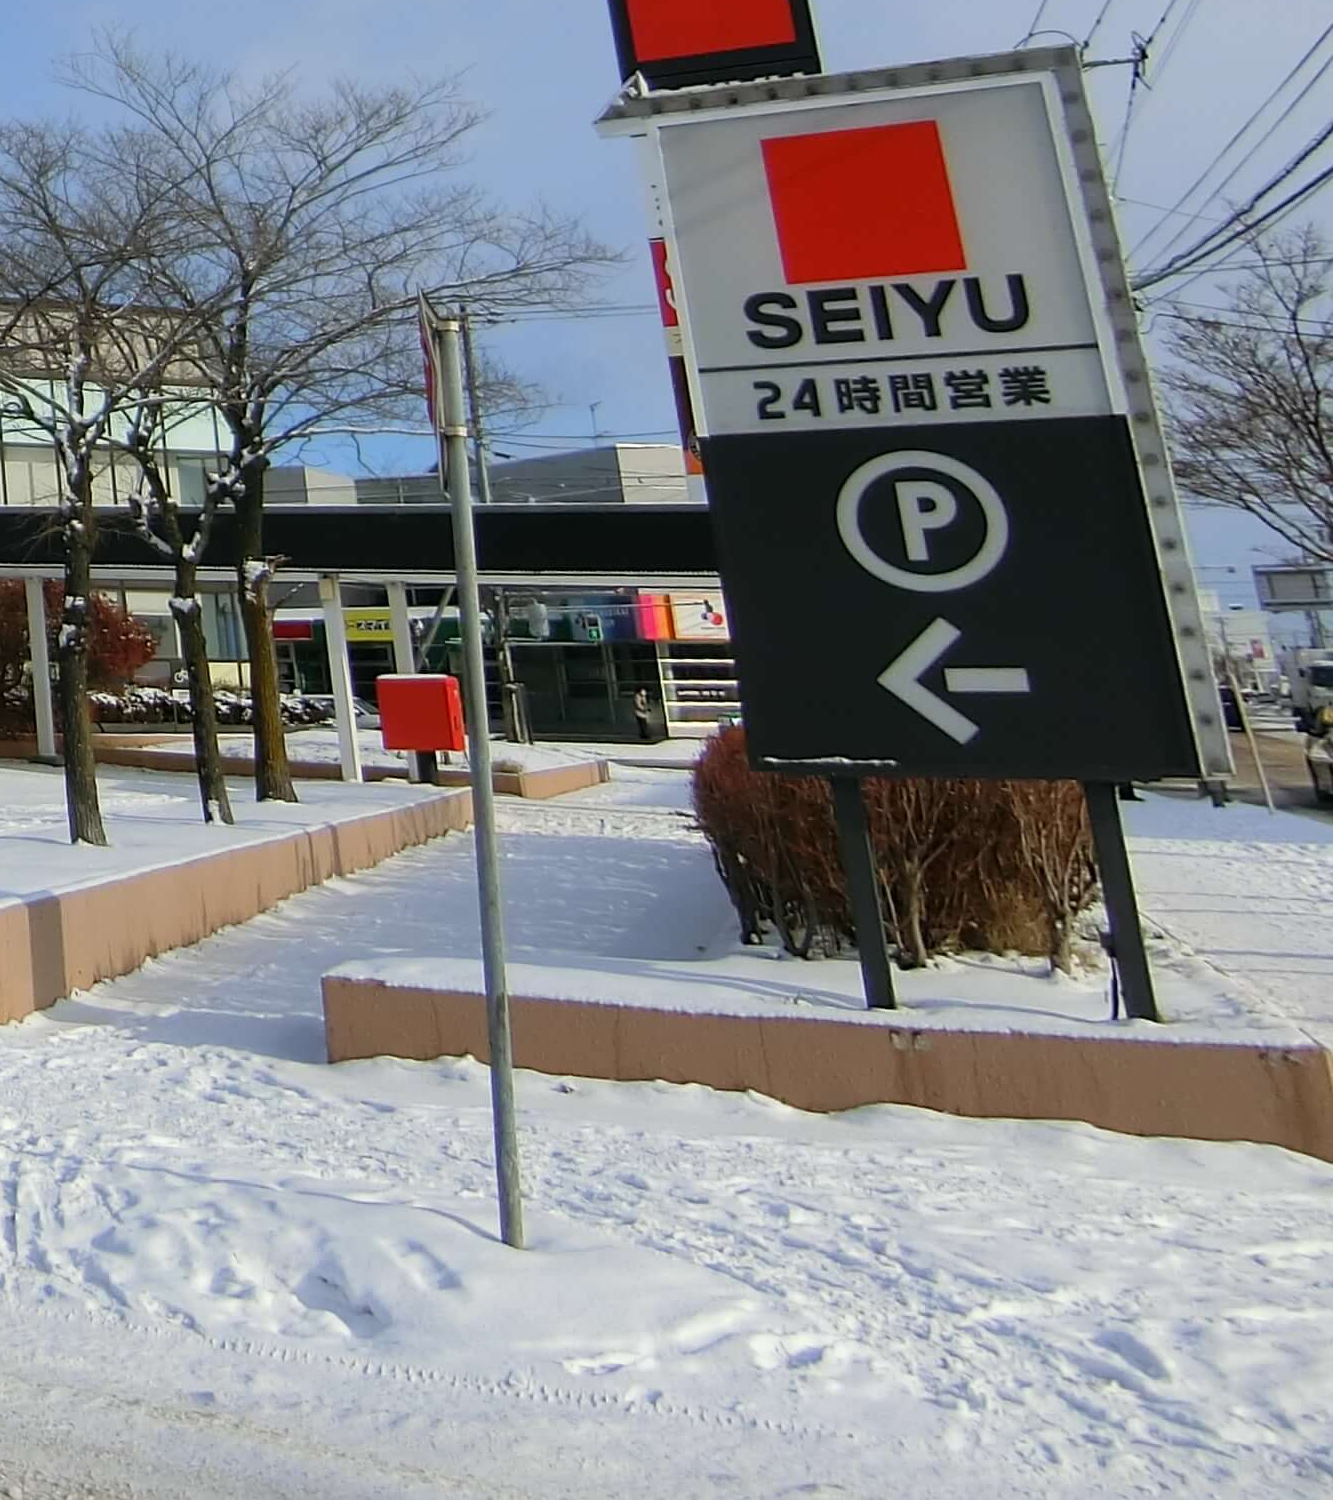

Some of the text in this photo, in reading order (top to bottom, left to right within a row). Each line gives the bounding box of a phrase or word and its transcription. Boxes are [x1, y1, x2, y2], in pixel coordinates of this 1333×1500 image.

[744, 274, 1030, 349] SEIYU
[753, 366, 1051, 419] 24時間営業
[894, 480, 957, 561] P
